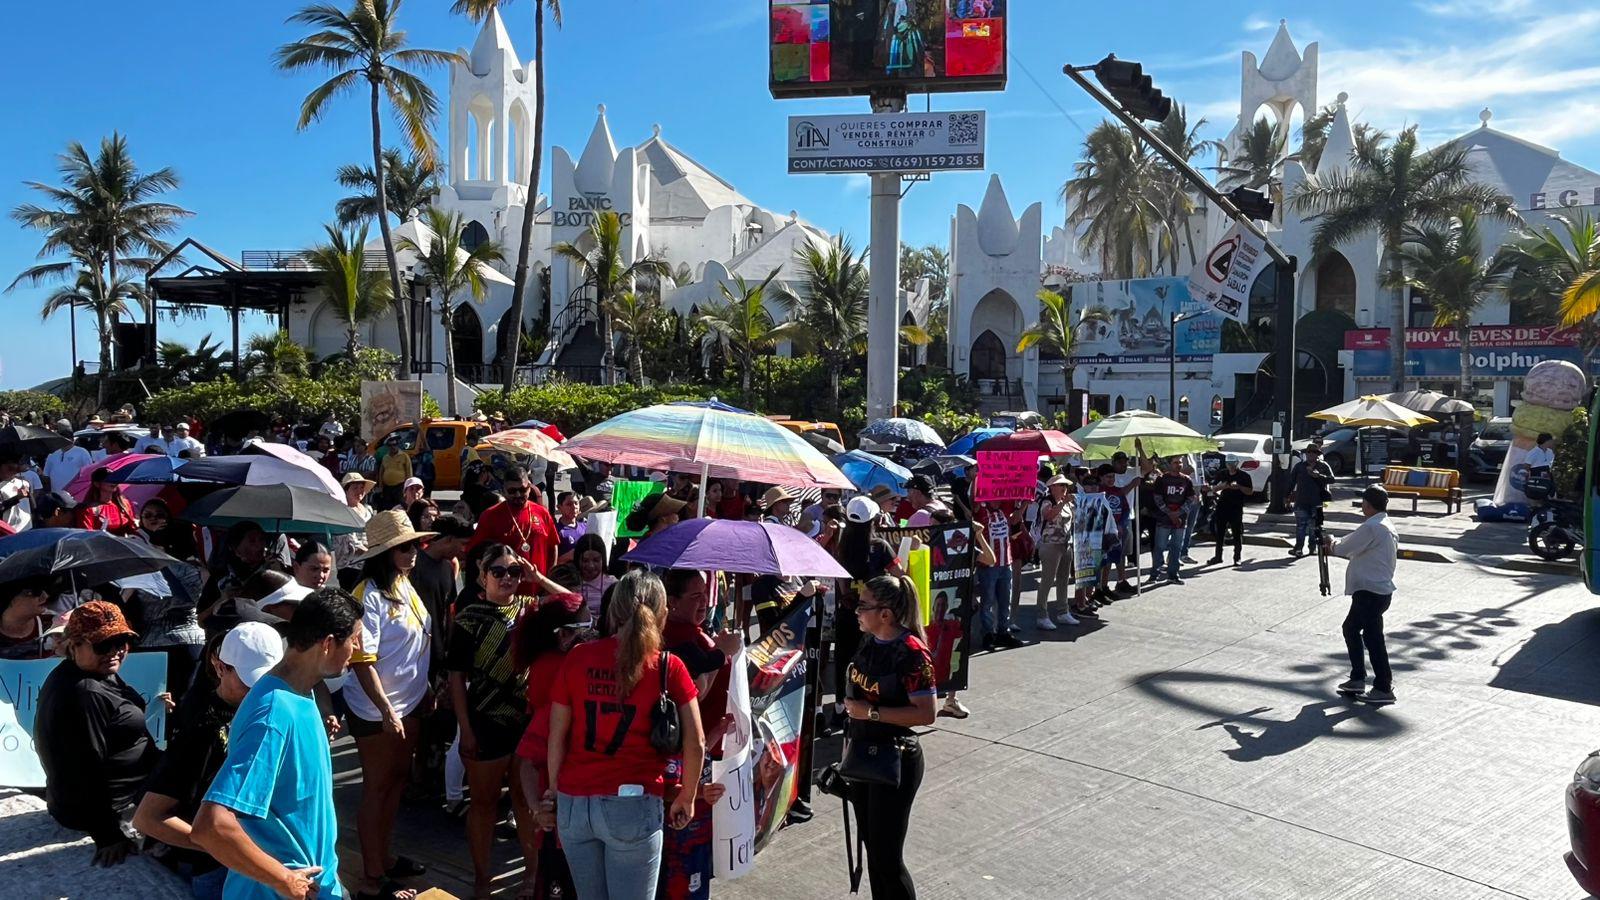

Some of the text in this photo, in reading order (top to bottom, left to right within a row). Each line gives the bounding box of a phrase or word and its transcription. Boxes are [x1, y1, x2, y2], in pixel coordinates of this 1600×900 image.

[890, 120, 943, 129] COMPRAR
[890, 157, 923, 168] (669)
[925, 156, 945, 167] 159
[949, 156, 963, 166] 28
[966, 155, 980, 165] 55
[568, 196, 612, 211] PANIC
[554, 211, 632, 227] BOTC
[1405, 331, 1441, 343] HOY
[1515, 328, 1541, 341] DE
[584, 700, 637, 756] 17
